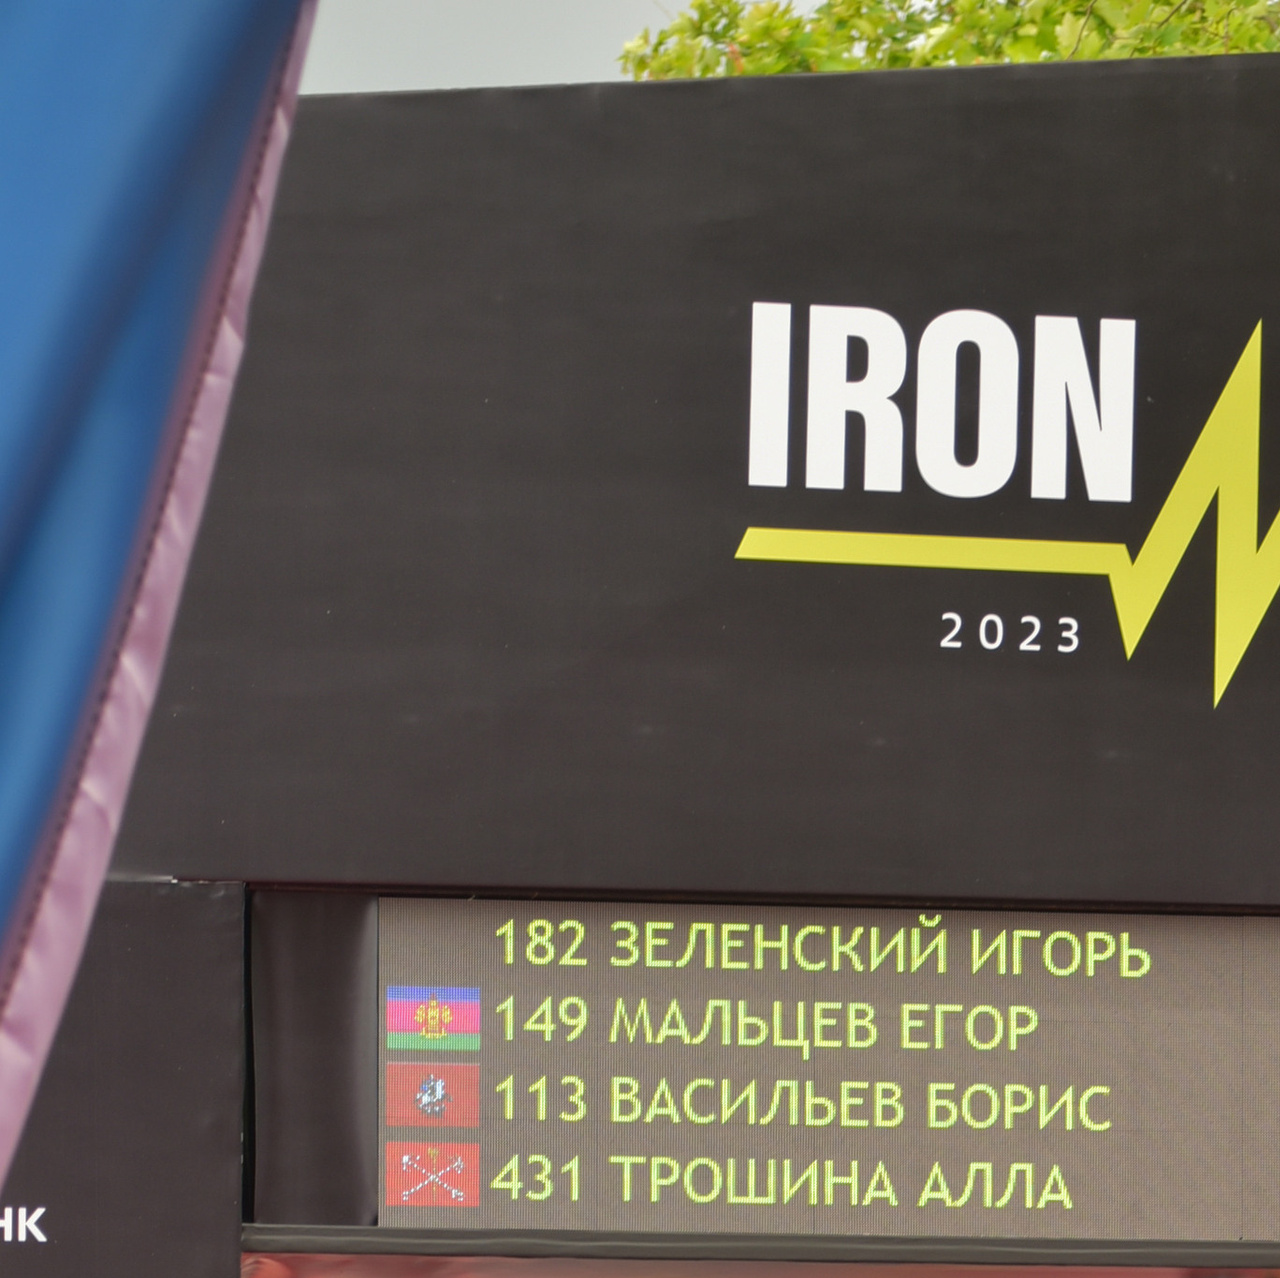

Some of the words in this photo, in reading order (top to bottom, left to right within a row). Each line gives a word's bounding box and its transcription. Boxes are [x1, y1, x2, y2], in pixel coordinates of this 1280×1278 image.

[748, 301, 1136, 503] IRON
[939, 612, 1081, 654] 2023
[494, 919, 589, 968] 182
[609, 912, 948, 974] ЗЕЛЕНСКИЙ
[970, 930, 1153, 979] ИГОРЬ
[494, 995, 589, 1043] 149
[608, 997, 879, 1060] МАЛЬЦЕВ
[900, 1004, 1040, 1052] ЕГОР
[494, 1074, 589, 1122] 113
[610, 1077, 905, 1128] ВАСИЛЬЕВ
[926, 1082, 1113, 1132] БОРИС
[490, 1153, 582, 1202] 431
[609, 1155, 899, 1208] ТРОШИНА
[917, 1160, 1074, 1211] АЛЛА
